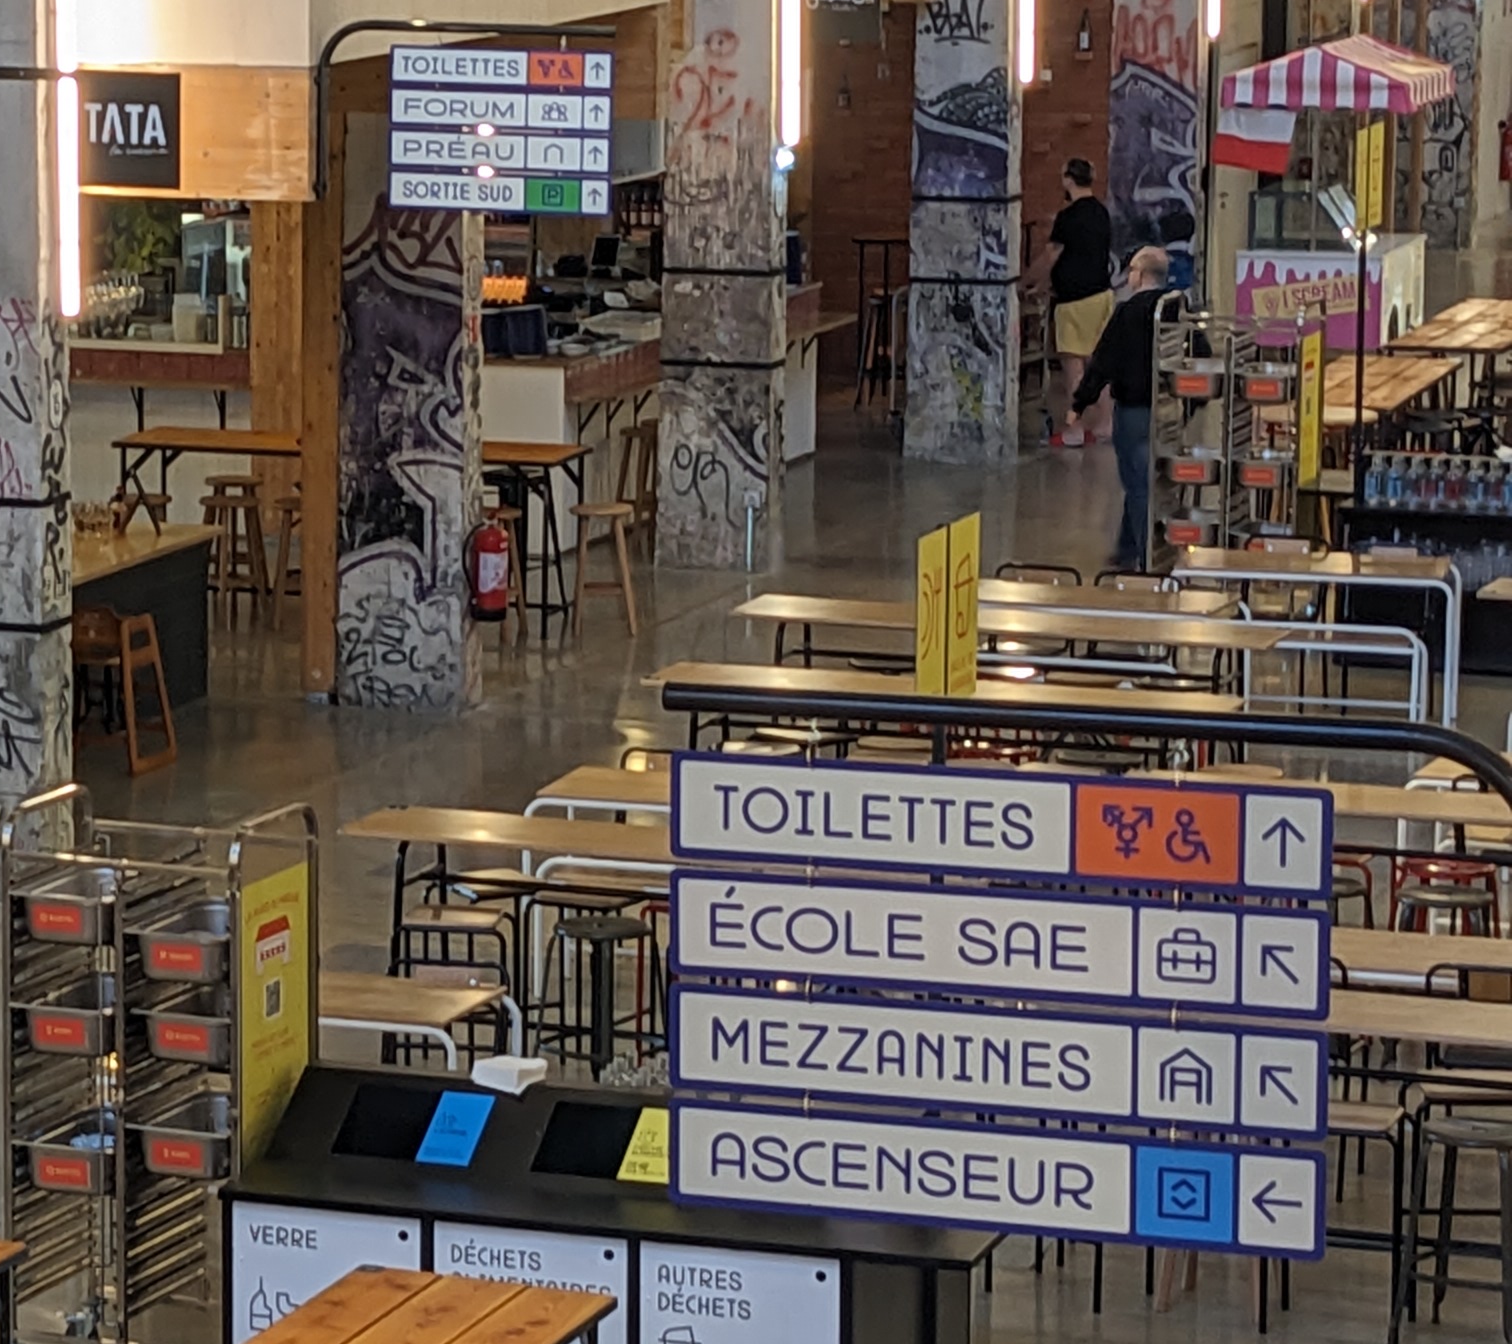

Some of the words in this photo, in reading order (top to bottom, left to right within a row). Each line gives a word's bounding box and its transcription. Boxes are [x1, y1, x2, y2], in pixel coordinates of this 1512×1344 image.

[401, 56, 520, 79] TOILETTES
[403, 97, 515, 119] FORUM
[83, 101, 167, 147] TATA
[403, 135, 515, 162] PRÉAU
[402, 179, 471, 202] SORTIE
[477, 183, 513, 203] SUD
[713, 783, 1035, 852] TOILETTES
[708, 885, 926, 962] ÉCOLE
[957, 917, 1090, 973] SAE
[710, 1015, 1093, 1093] MEZZANINES
[710, 1131, 1096, 1212] ASCENSEUR
[248, 1223, 319, 1251] VERRE
[450, 1236, 543, 1272] DÉCHETS
[657, 1263, 743, 1292] AUTRES
[656, 1290, 752, 1321] DÉCHETS
